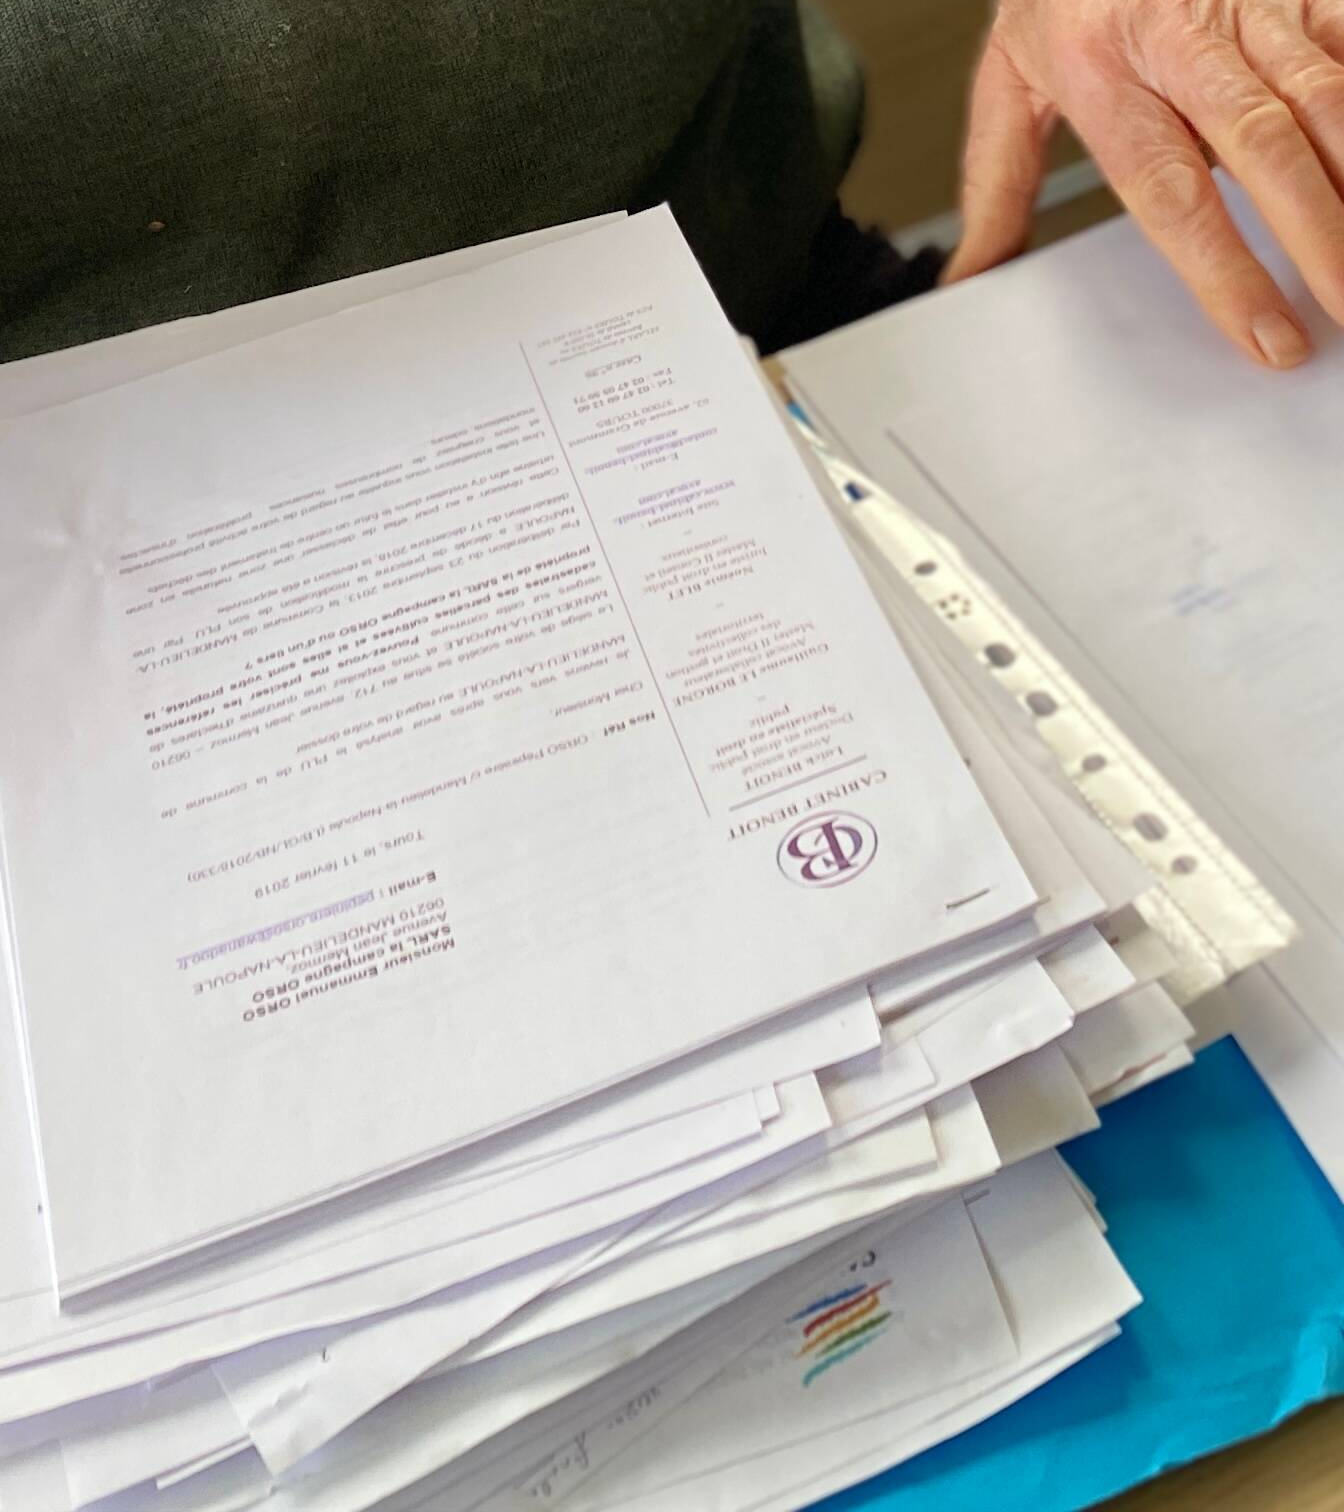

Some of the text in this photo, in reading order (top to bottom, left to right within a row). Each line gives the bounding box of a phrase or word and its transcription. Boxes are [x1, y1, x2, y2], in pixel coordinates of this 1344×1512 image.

[747, 730, 765, 742] en
[723, 767, 889, 842] CABINET BENOIT
[253, 826, 424, 901] Tours, le 11 février 2019
[387, 869, 436, 897] E-mail
[391, 909, 448, 940] Avenue
[191, 895, 444, 1000] 06210 MANDELIEU-LA-NAPOULE
[352, 929, 389, 953] Jean
[388, 939, 403, 954] la
[241, 935, 455, 1024] Monsieur Emmanuel ORSO
[303, 943, 384, 986] campagne
[250, 975, 300, 1004] ORSO
